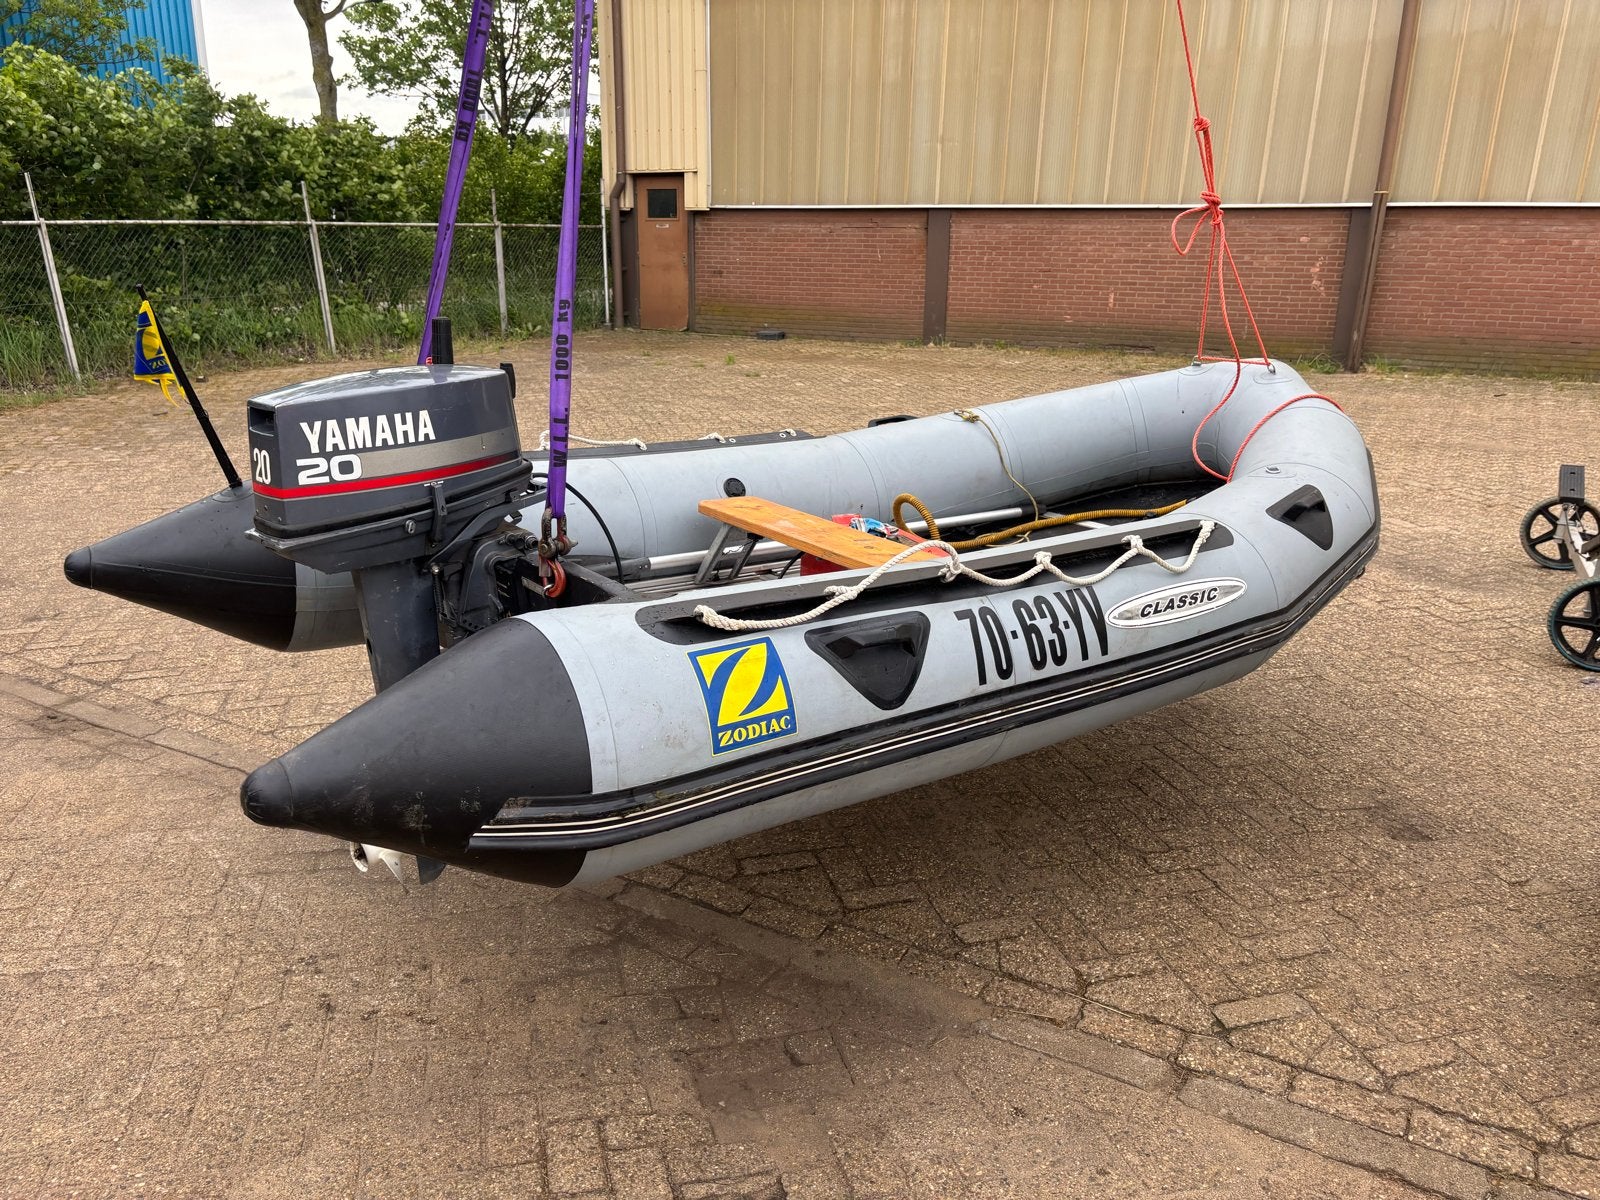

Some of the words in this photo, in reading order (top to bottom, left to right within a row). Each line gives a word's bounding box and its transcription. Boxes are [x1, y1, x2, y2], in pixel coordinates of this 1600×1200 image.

[461, 69, 481, 112] 1000
[554, 334, 570, 382] 1000
[299, 409, 436, 454] YAMAHA
[553, 407, 569, 468] W.L.L.
[253, 447, 272, 485] 20
[295, 454, 363, 486] 20
[1140, 587, 1218, 618] CLASSIC
[718, 715, 791, 747] ZODIAC
